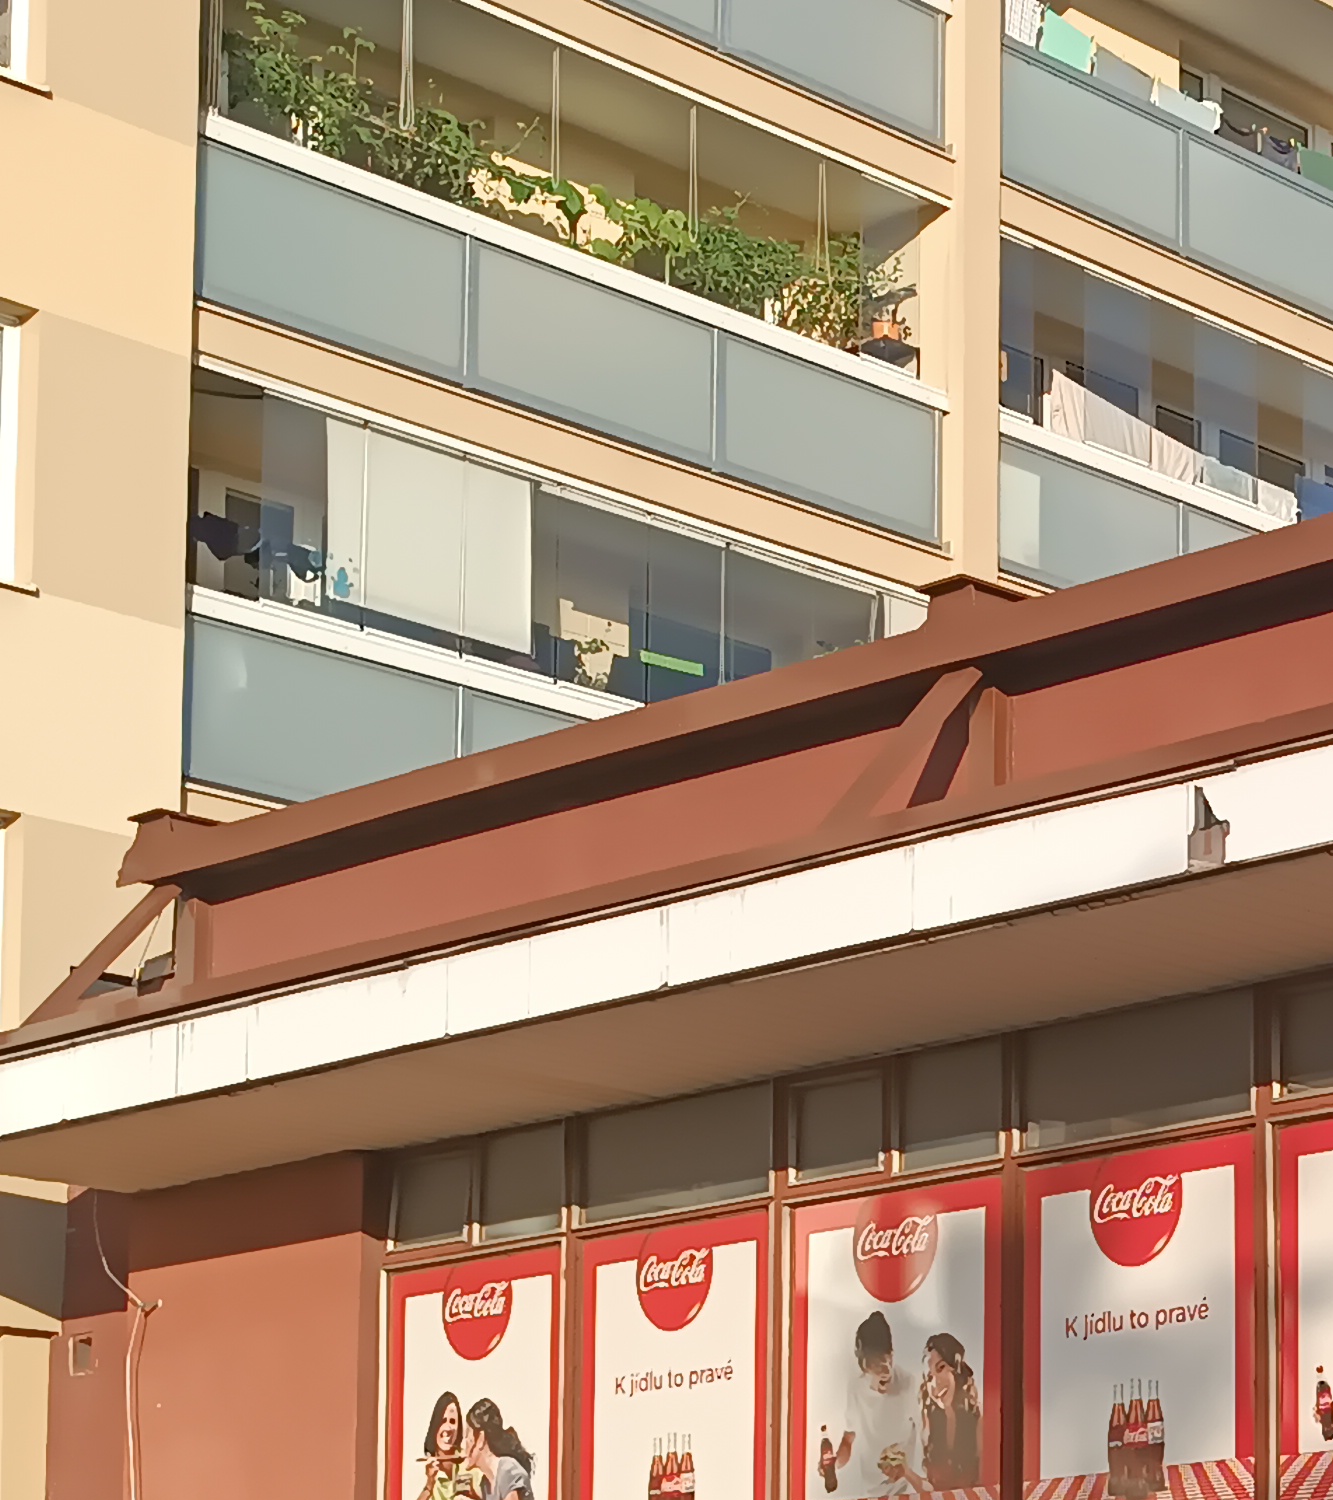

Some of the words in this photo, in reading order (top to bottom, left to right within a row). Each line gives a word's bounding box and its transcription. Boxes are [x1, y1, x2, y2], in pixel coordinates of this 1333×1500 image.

[1065, 1316, 1078, 1338] K
[1083, 1310, 1124, 1341] jídlu
[1130, 1310, 1149, 1330] to
[1155, 1296, 1209, 1330] pravé
[615, 1376, 626, 1395] K
[629, 1368, 663, 1398] jídlu
[667, 1368, 684, 1389] to
[688, 1358, 734, 1390] pravé
